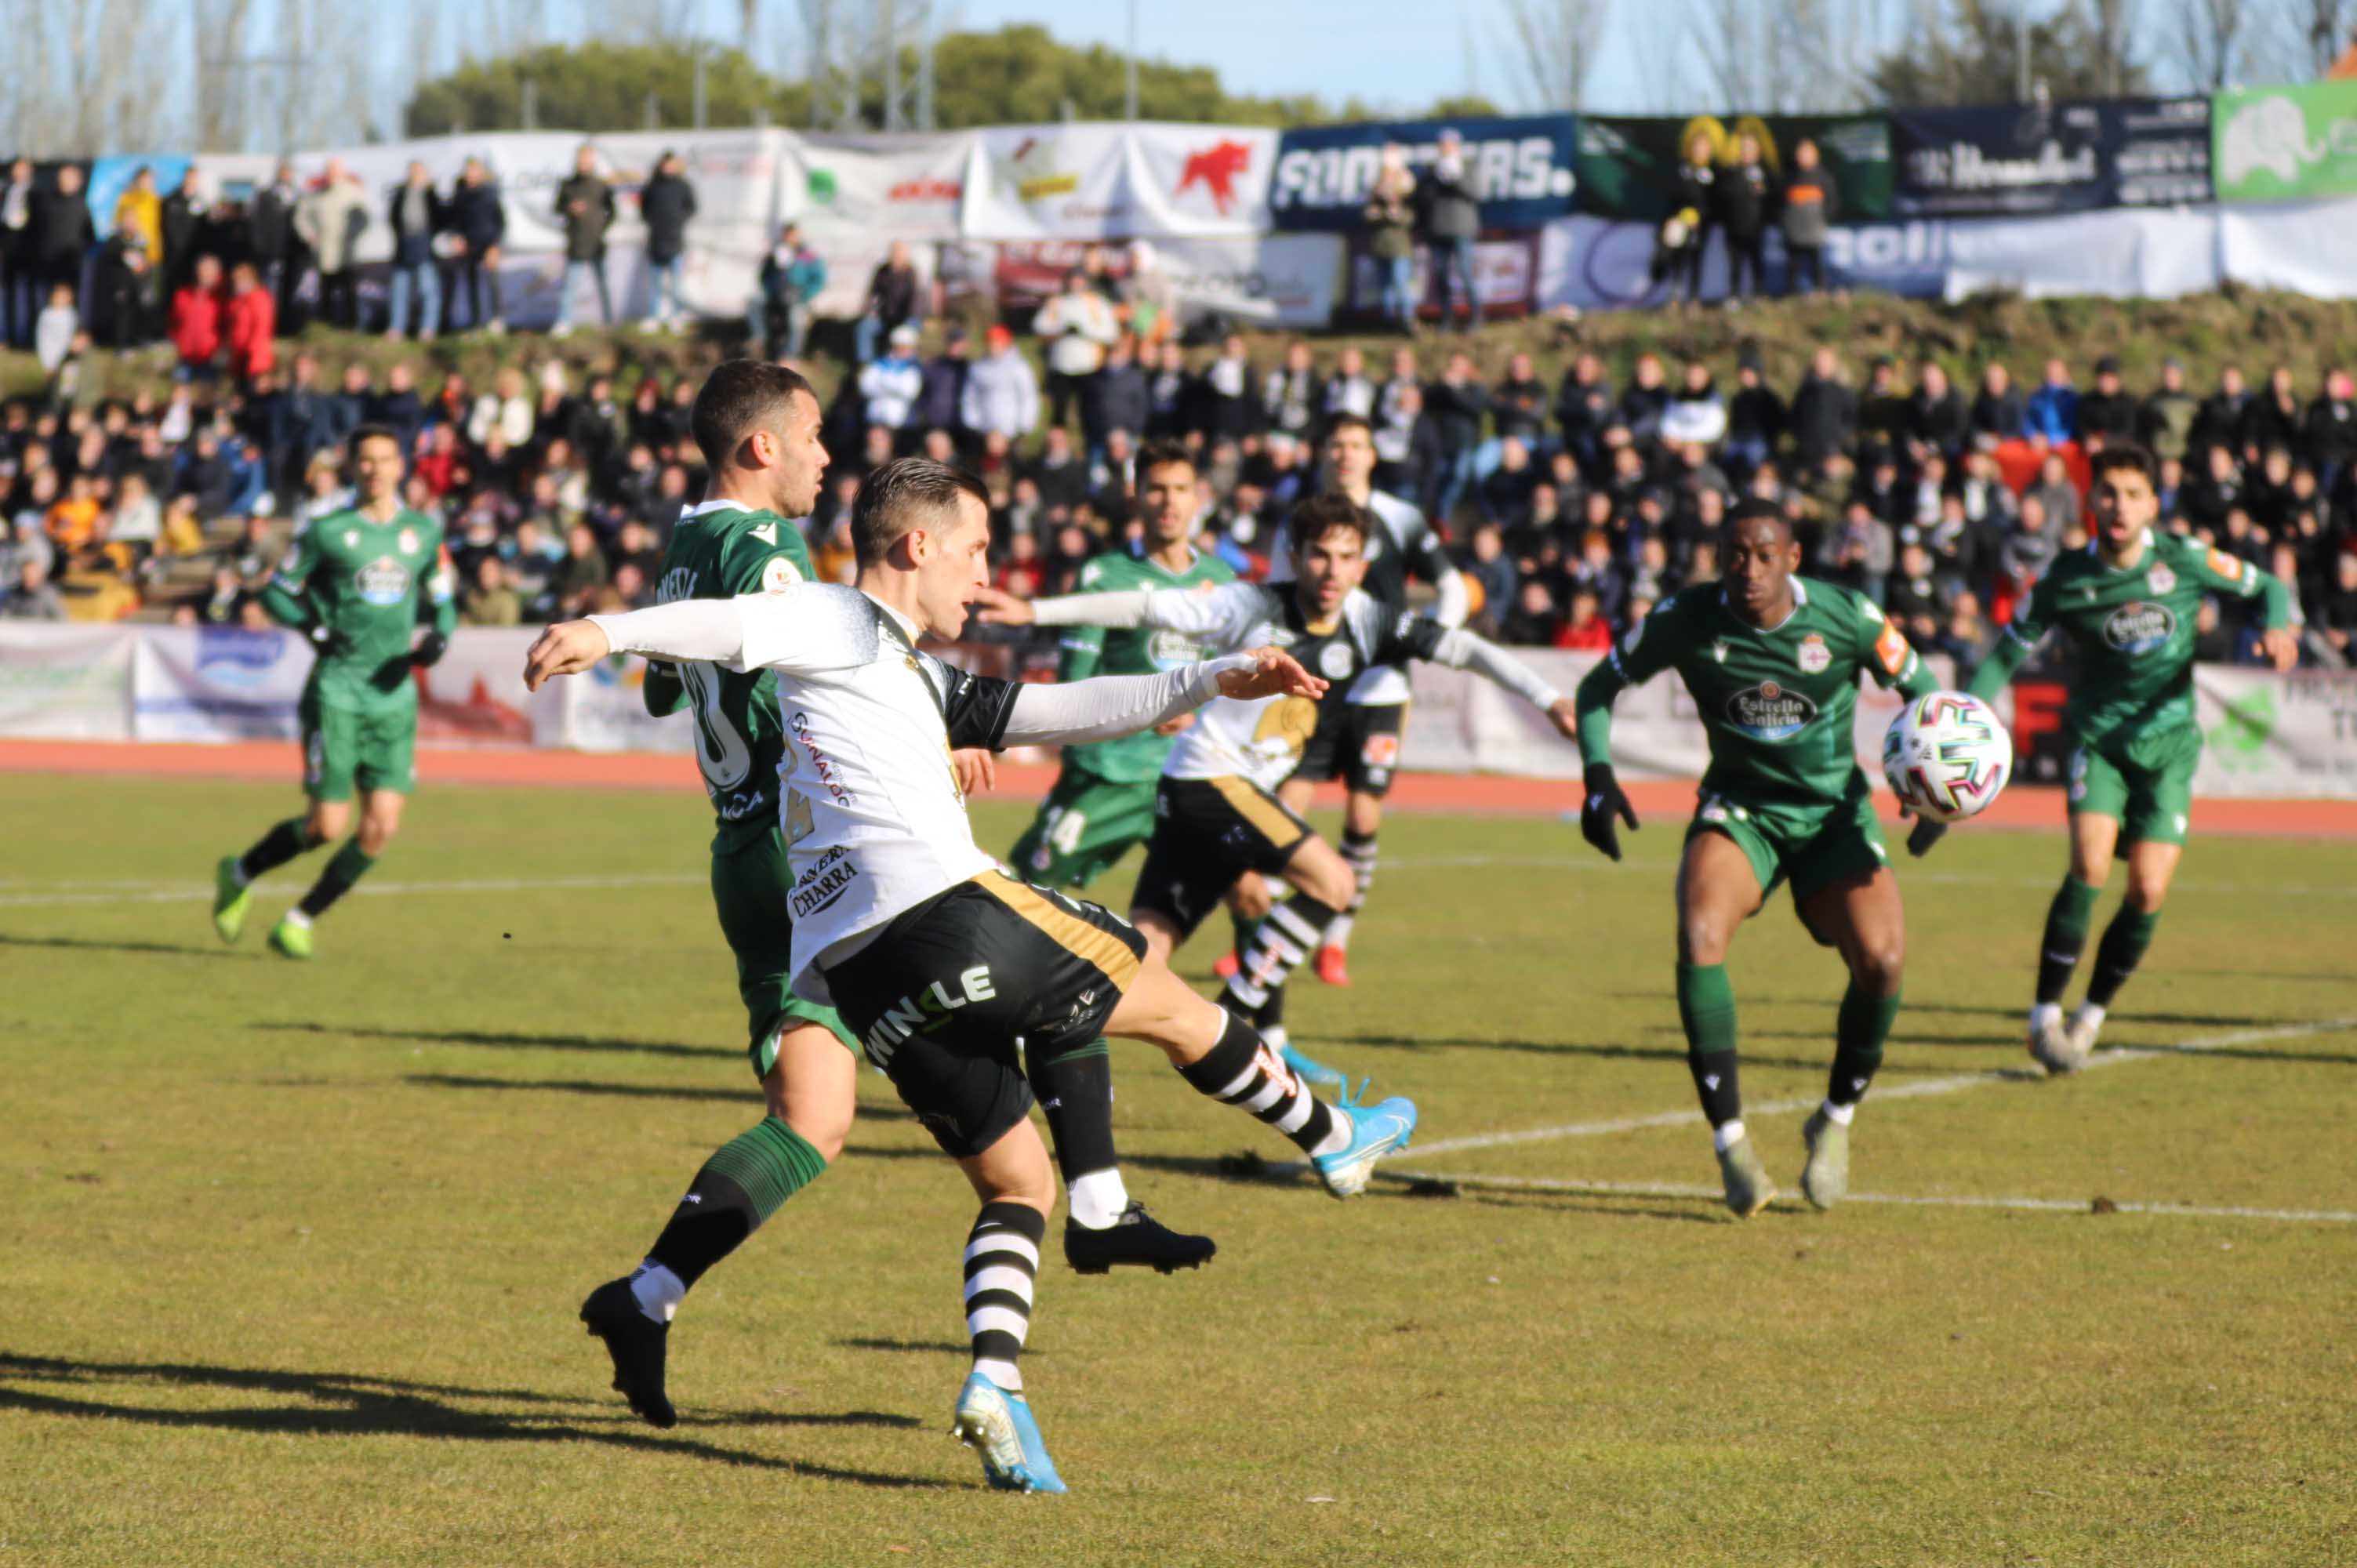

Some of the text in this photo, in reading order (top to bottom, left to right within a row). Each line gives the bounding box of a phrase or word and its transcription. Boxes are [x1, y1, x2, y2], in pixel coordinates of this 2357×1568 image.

[1739, 696, 1803, 713] Estrella
[1743, 711, 1801, 726] Galicia
[1040, 805, 1084, 854] 14
[793, 861, 859, 917] CHARRA
